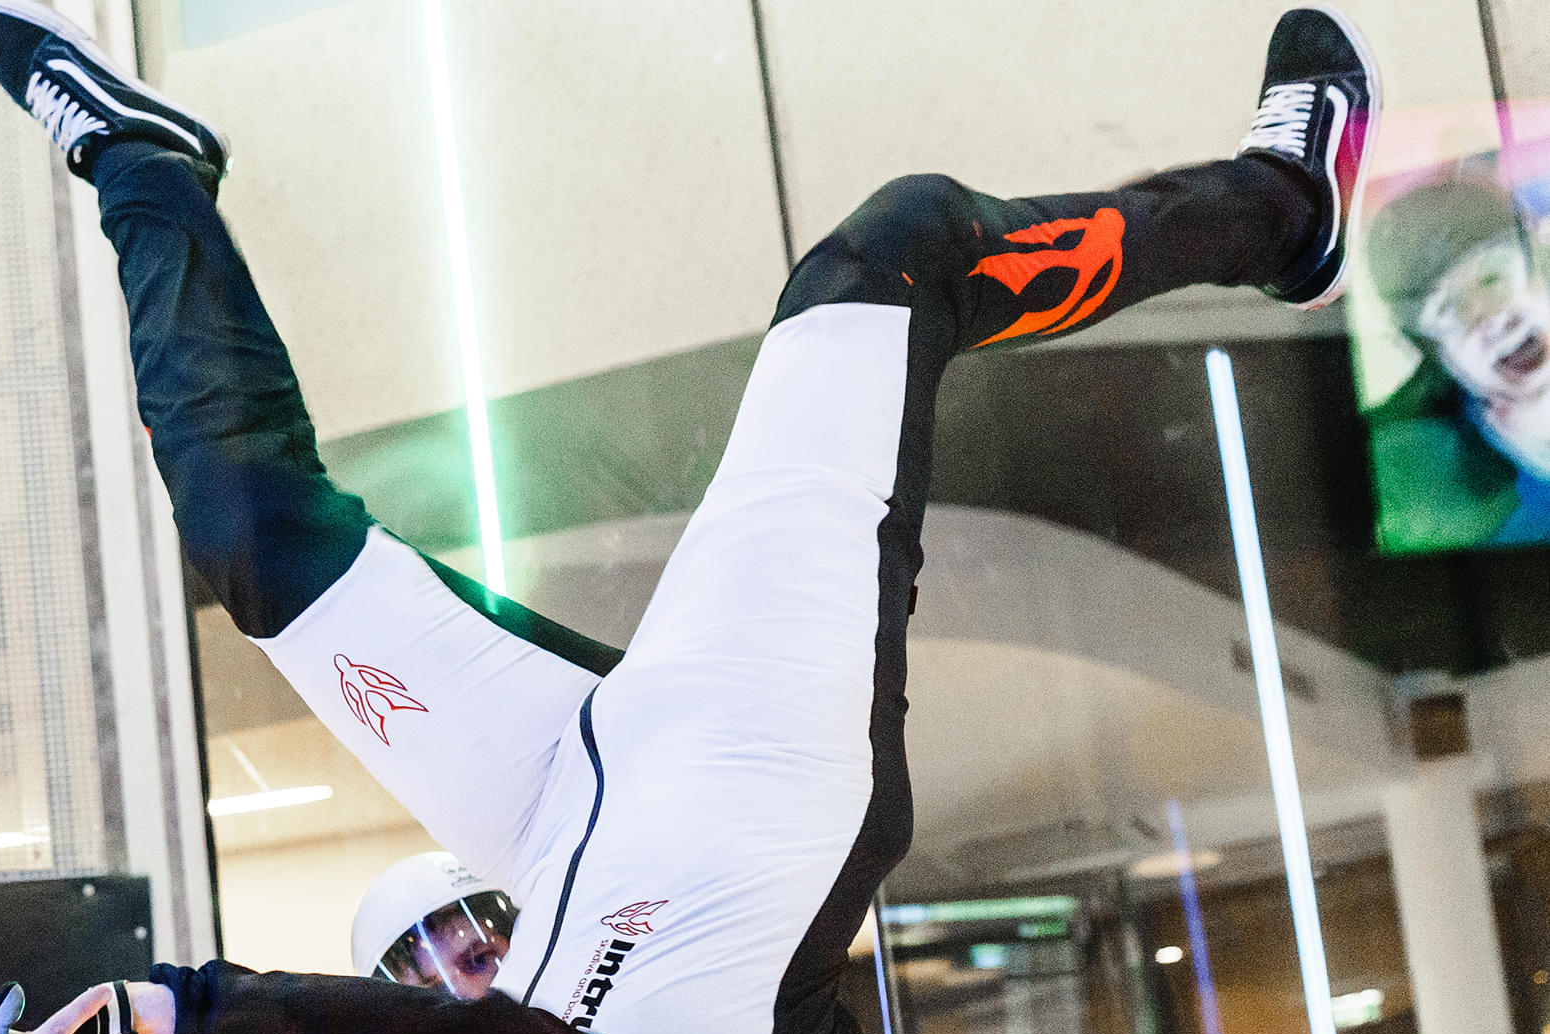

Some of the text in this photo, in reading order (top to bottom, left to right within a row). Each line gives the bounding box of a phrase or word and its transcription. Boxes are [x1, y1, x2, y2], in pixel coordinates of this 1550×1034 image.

[561, 939, 609, 1022] skydive and bas
